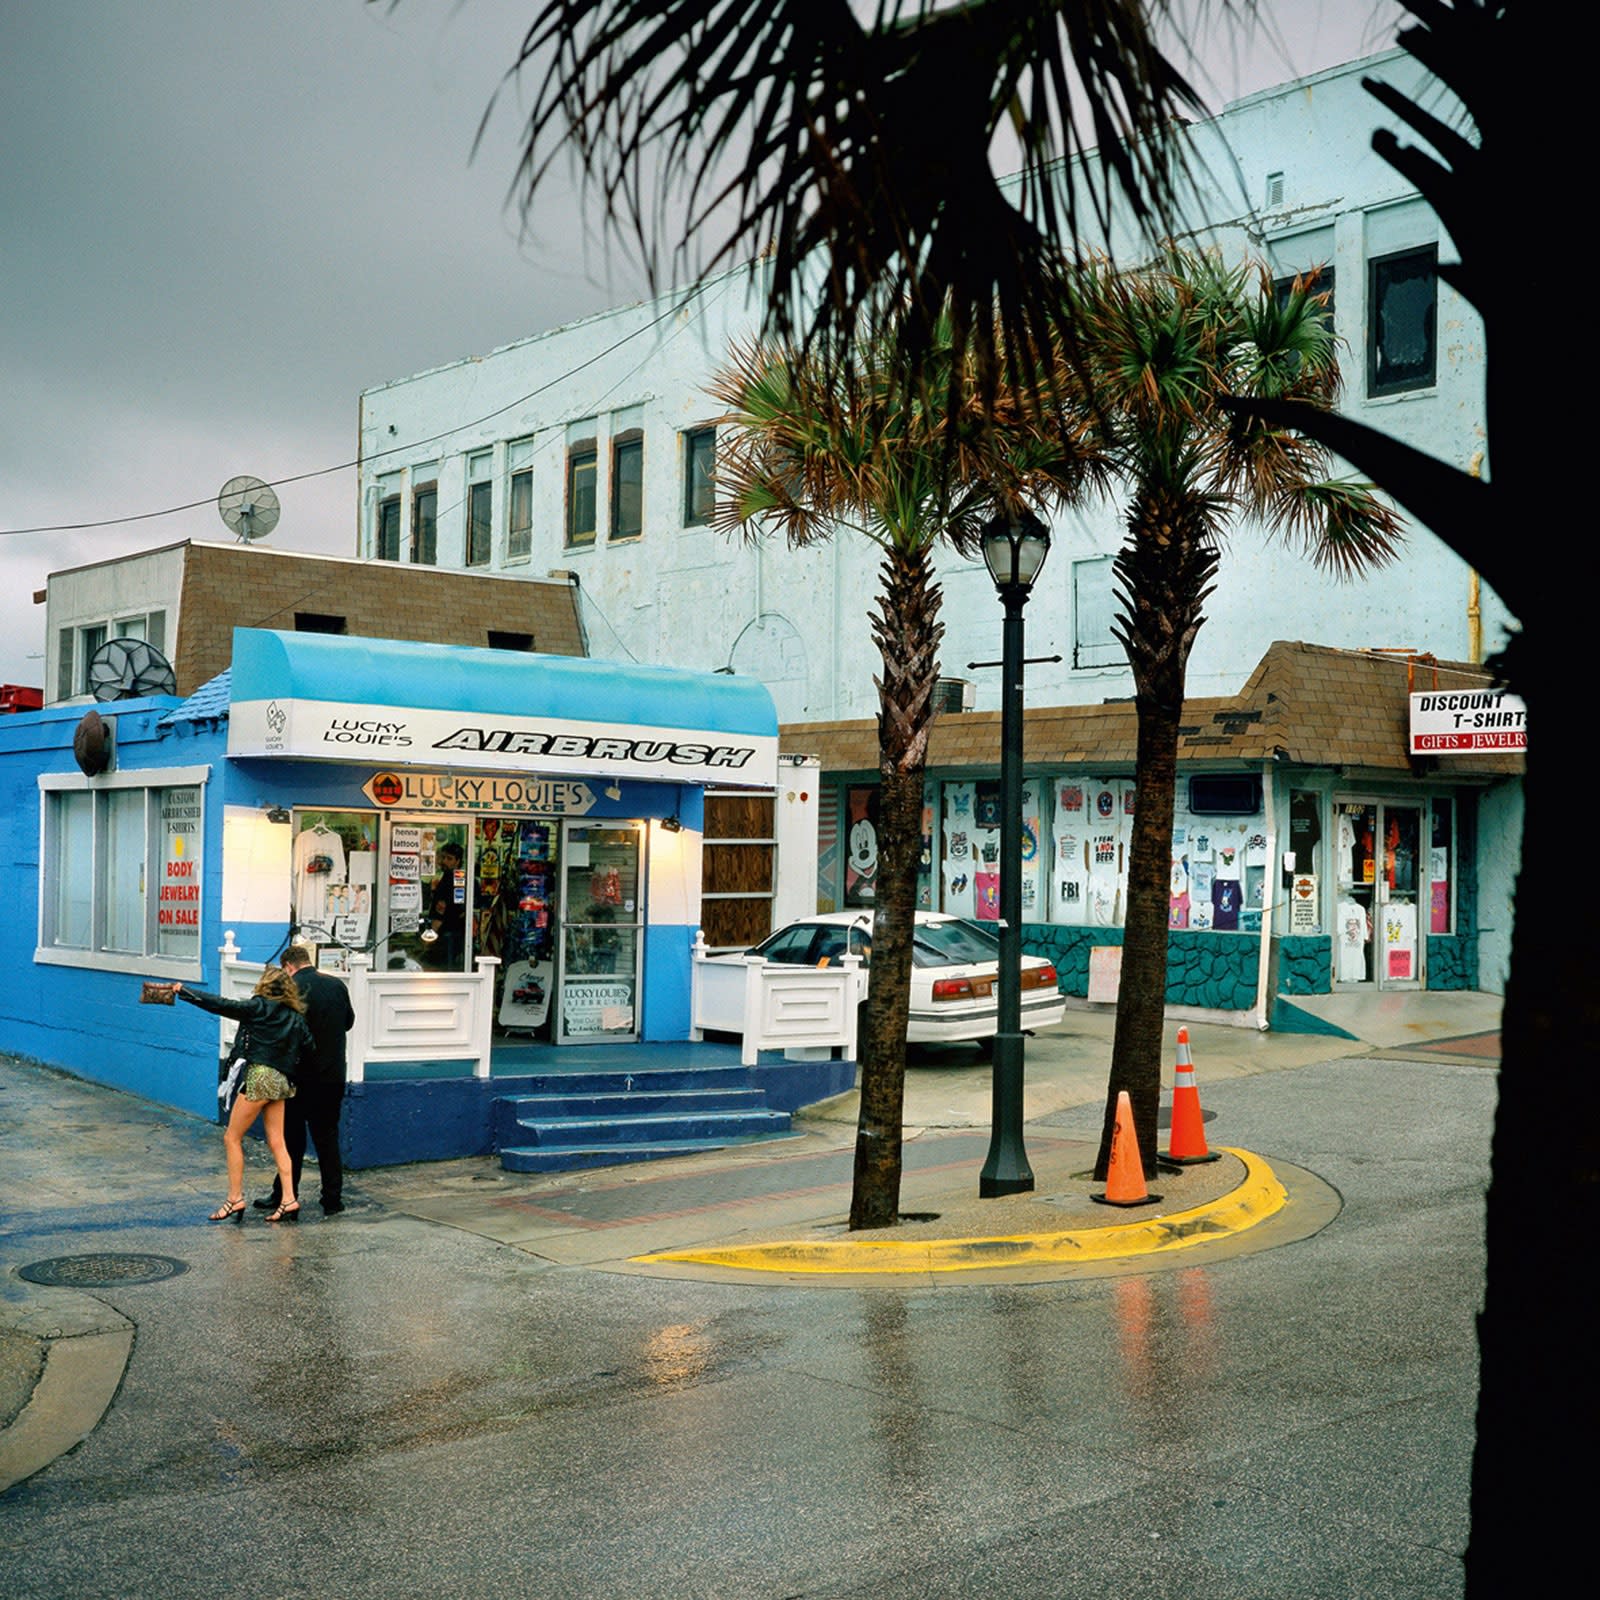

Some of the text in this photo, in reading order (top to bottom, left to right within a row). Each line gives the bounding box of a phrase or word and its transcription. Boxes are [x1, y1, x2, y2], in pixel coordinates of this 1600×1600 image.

[1420, 694, 1505, 712] DISCOUNT
[331, 719, 407, 733] LUCKY
[1453, 712, 1526, 728] T-SHIRT
[323, 732, 413, 746] LOUIE'S
[1421, 735, 1459, 748] GIFTS
[432, 728, 756, 768] AIRBRUSH
[406, 777, 583, 805] LUCKY LOUIE'S
[422, 800, 566, 812] ON THE BEACH
[393, 840, 419, 848] tattoos
[1100, 843, 1111, 851] NO
[396, 856, 415, 864] body
[1095, 853, 1114, 862] BEER
[167, 861, 193, 877] BODY
[391, 864, 417, 873] jewelry
[160, 886, 199, 900] JEWELRY
[1062, 881, 1079, 897] FBI
[159, 909, 198, 925] ON SALE
[565, 989, 593, 998] LUCKY
